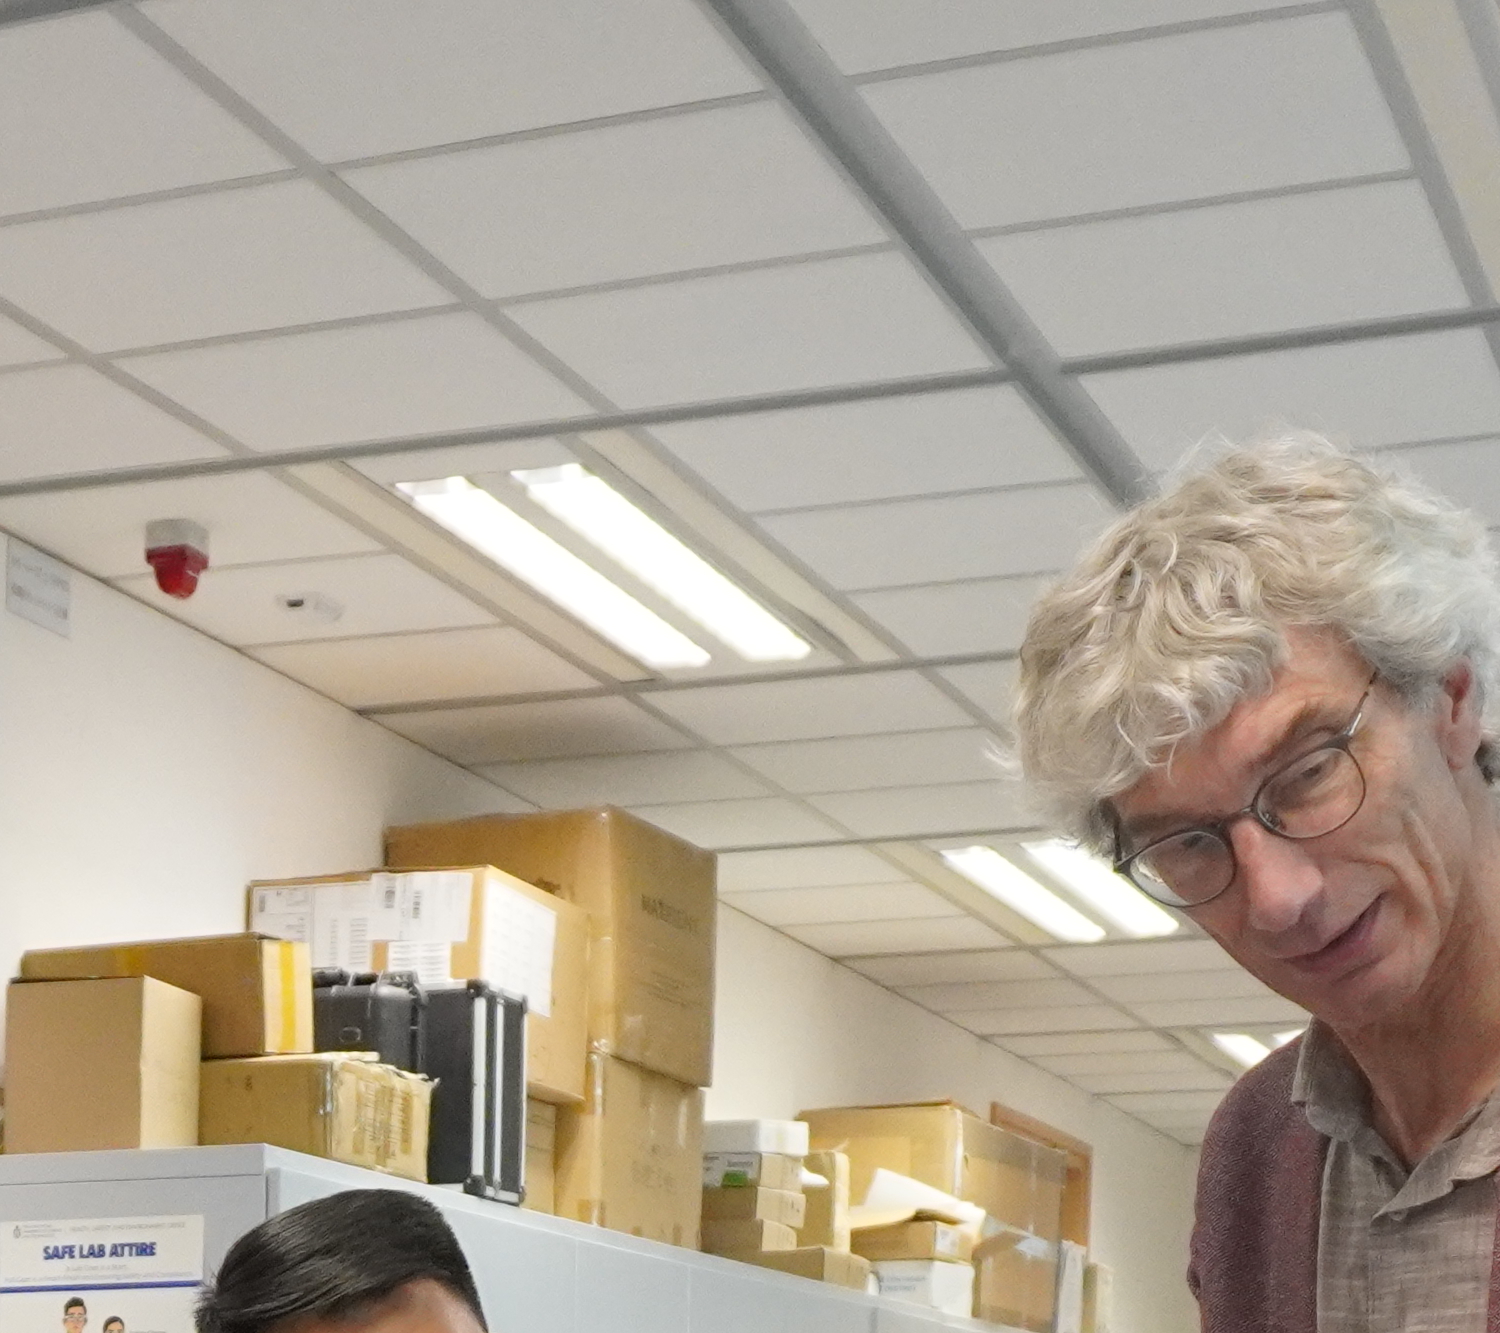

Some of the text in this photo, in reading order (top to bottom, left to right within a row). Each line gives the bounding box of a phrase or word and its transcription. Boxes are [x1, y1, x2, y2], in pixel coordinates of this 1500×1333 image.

[43, 1242, 157, 1260] SAFE LAB ATTIRE
